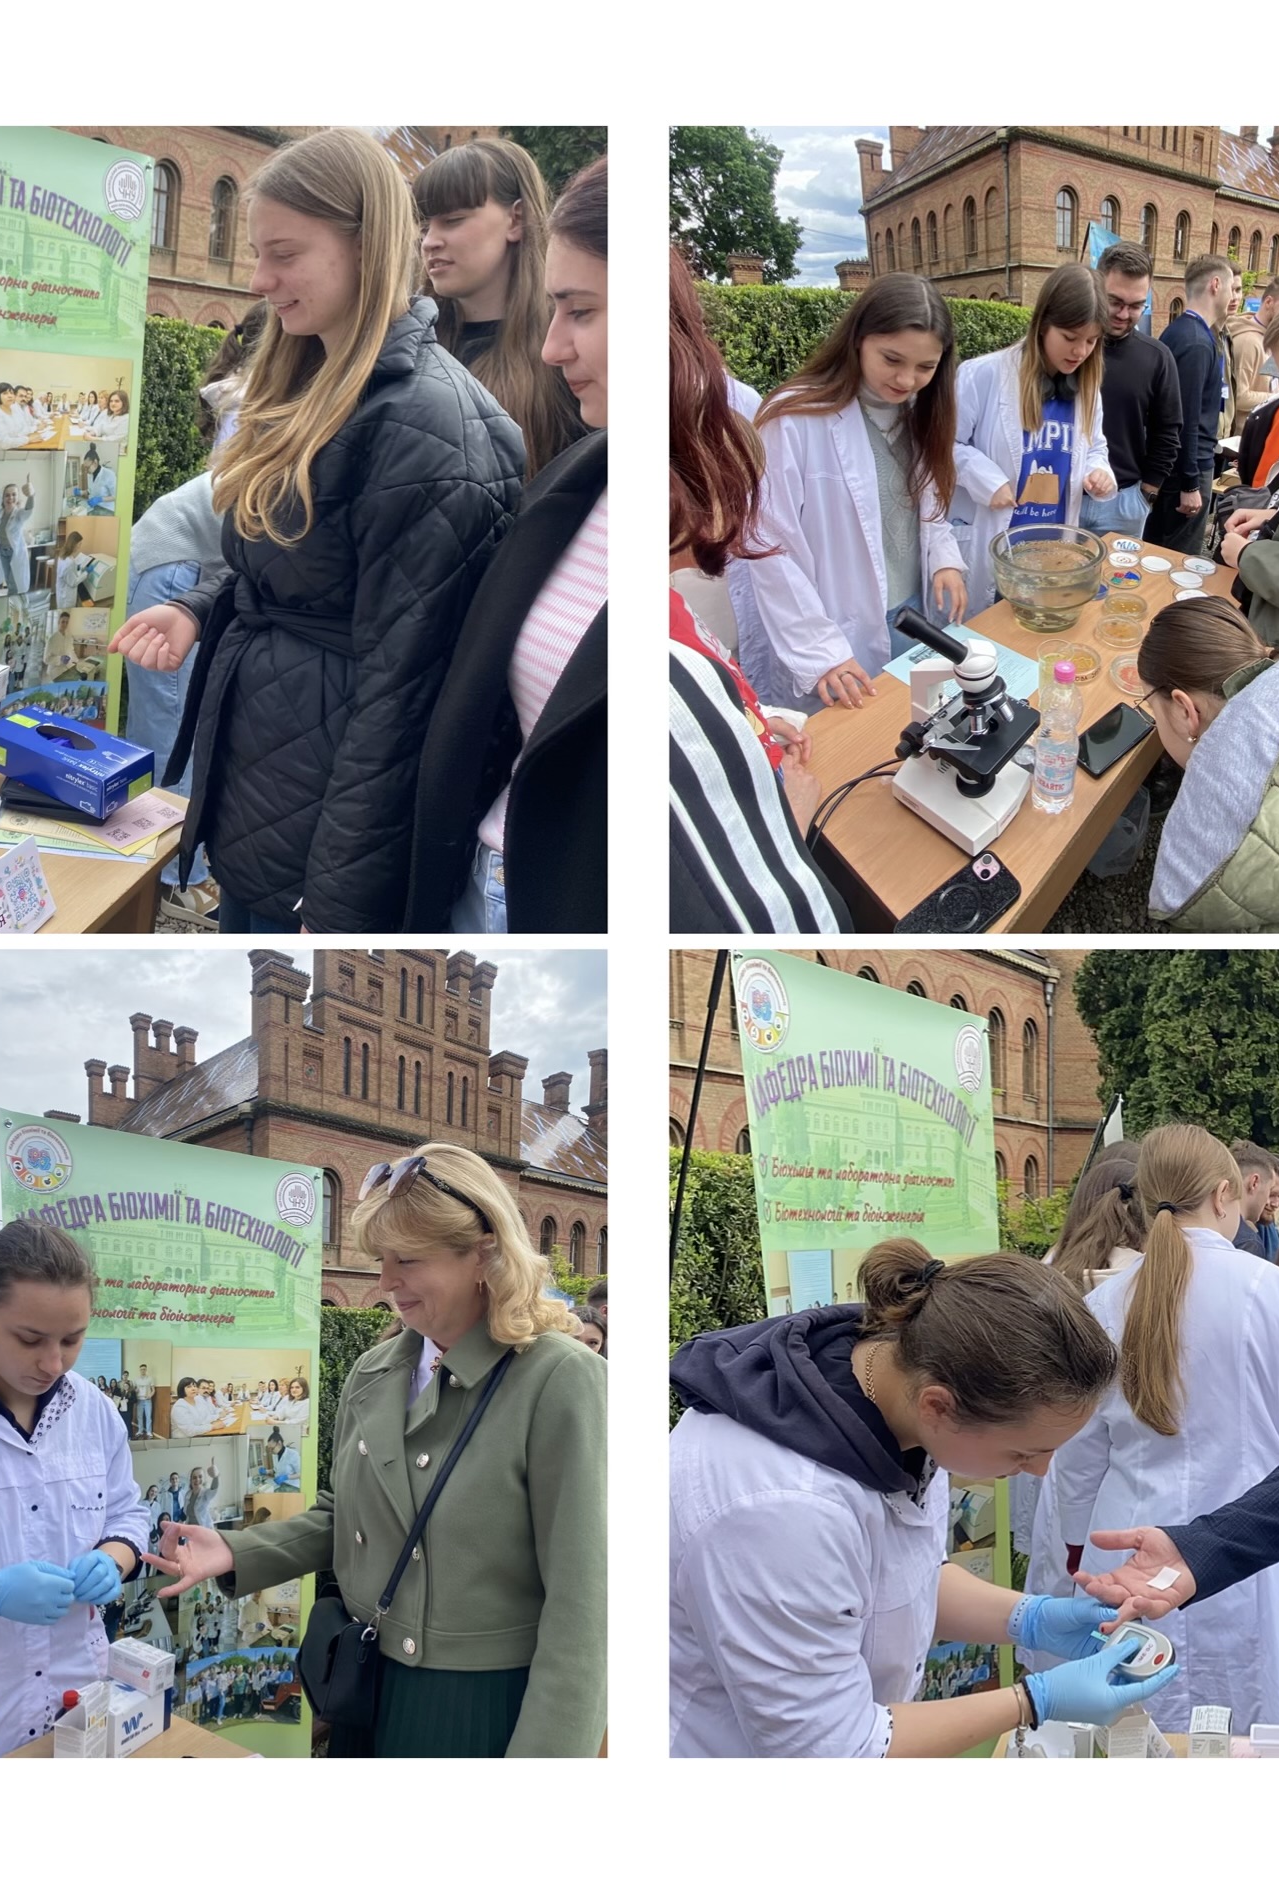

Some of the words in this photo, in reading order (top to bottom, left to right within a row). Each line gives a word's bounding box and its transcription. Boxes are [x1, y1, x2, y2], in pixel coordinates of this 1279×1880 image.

[8, 177, 26, 210] ТА
[28, 186, 136, 268] БІОТЕХНОЛОГІЇ
[819, 1047, 879, 1089] БІОХІМІЇ
[882, 1056, 896, 1094] ТА
[816, 1166, 833, 1178] та
[108, 1190, 186, 1222] БІОХІМІЇ
[184, 1197, 202, 1226] ТА
[205, 1201, 309, 1268] БІОТЕХНОЛОГІЇ
[104, 1278, 124, 1288] та
[126, 1274, 208, 1297] лабораторна
[90, 1307, 138, 1321] нології
[139, 1311, 157, 1322] та
